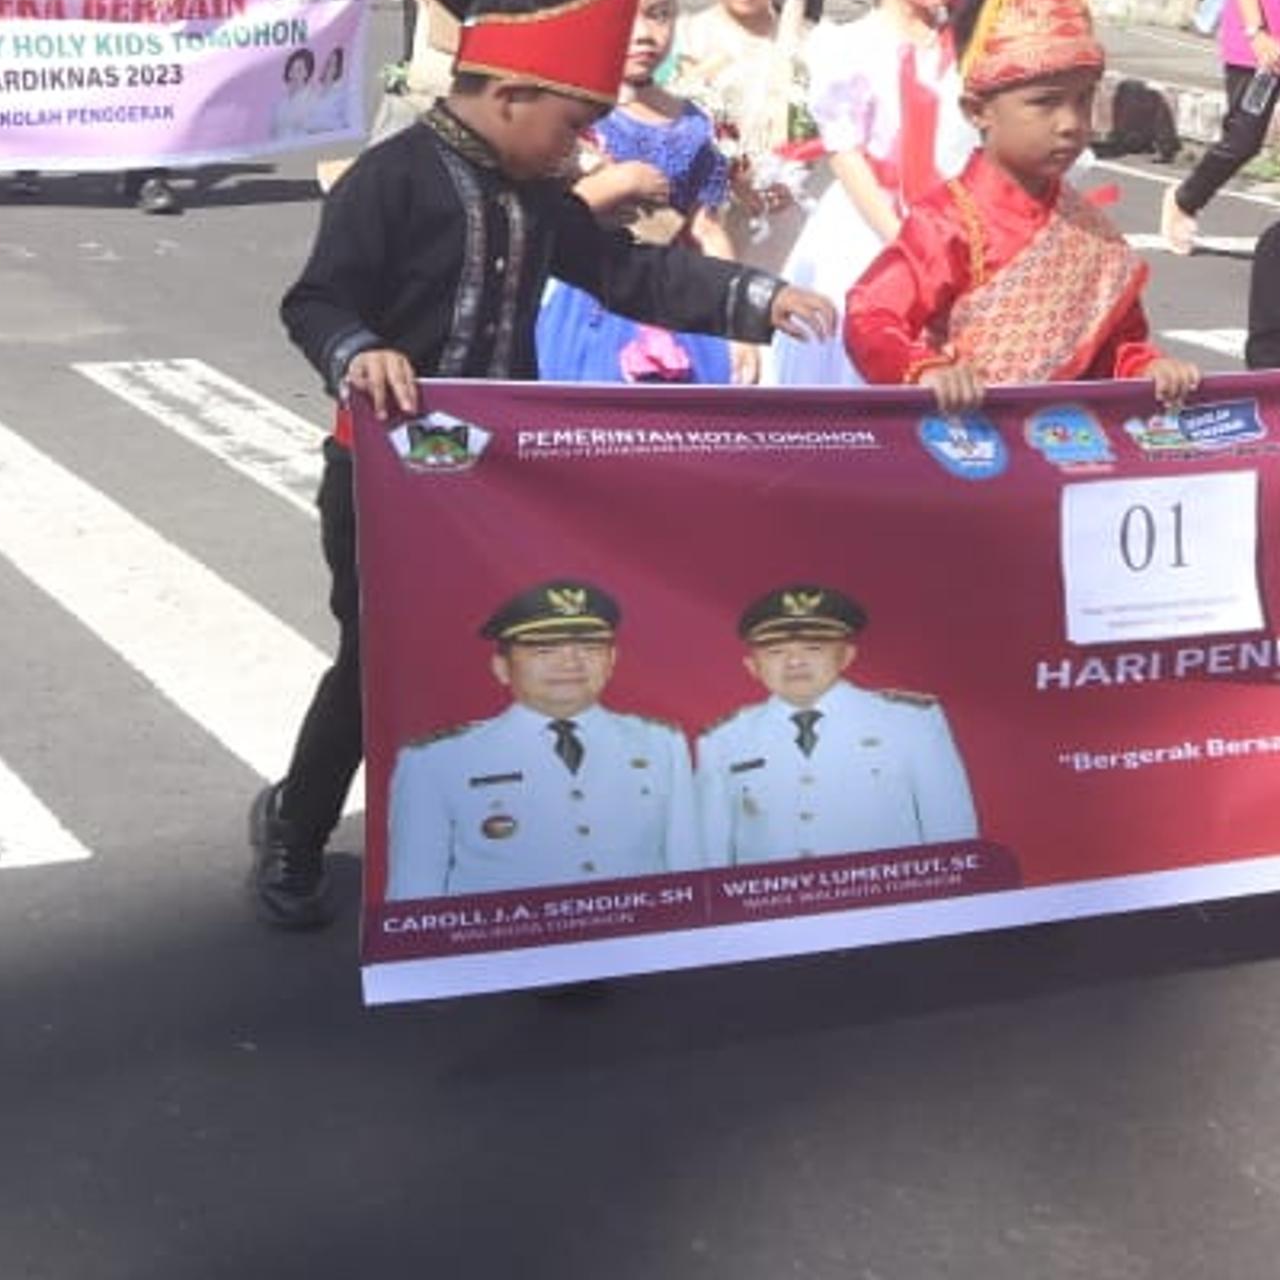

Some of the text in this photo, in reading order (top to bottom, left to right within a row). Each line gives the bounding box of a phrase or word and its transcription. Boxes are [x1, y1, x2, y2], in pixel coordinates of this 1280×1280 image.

[13, 33, 86, 61] HOLY
[95, 32, 164, 58] KIDS
[126, 63, 184, 87] 2023
[1118, 501, 1192, 572] 01
[1036, 653, 1161, 690] HARI
[661, 885, 693, 903] SH
[722, 874, 814, 898] WENNY
